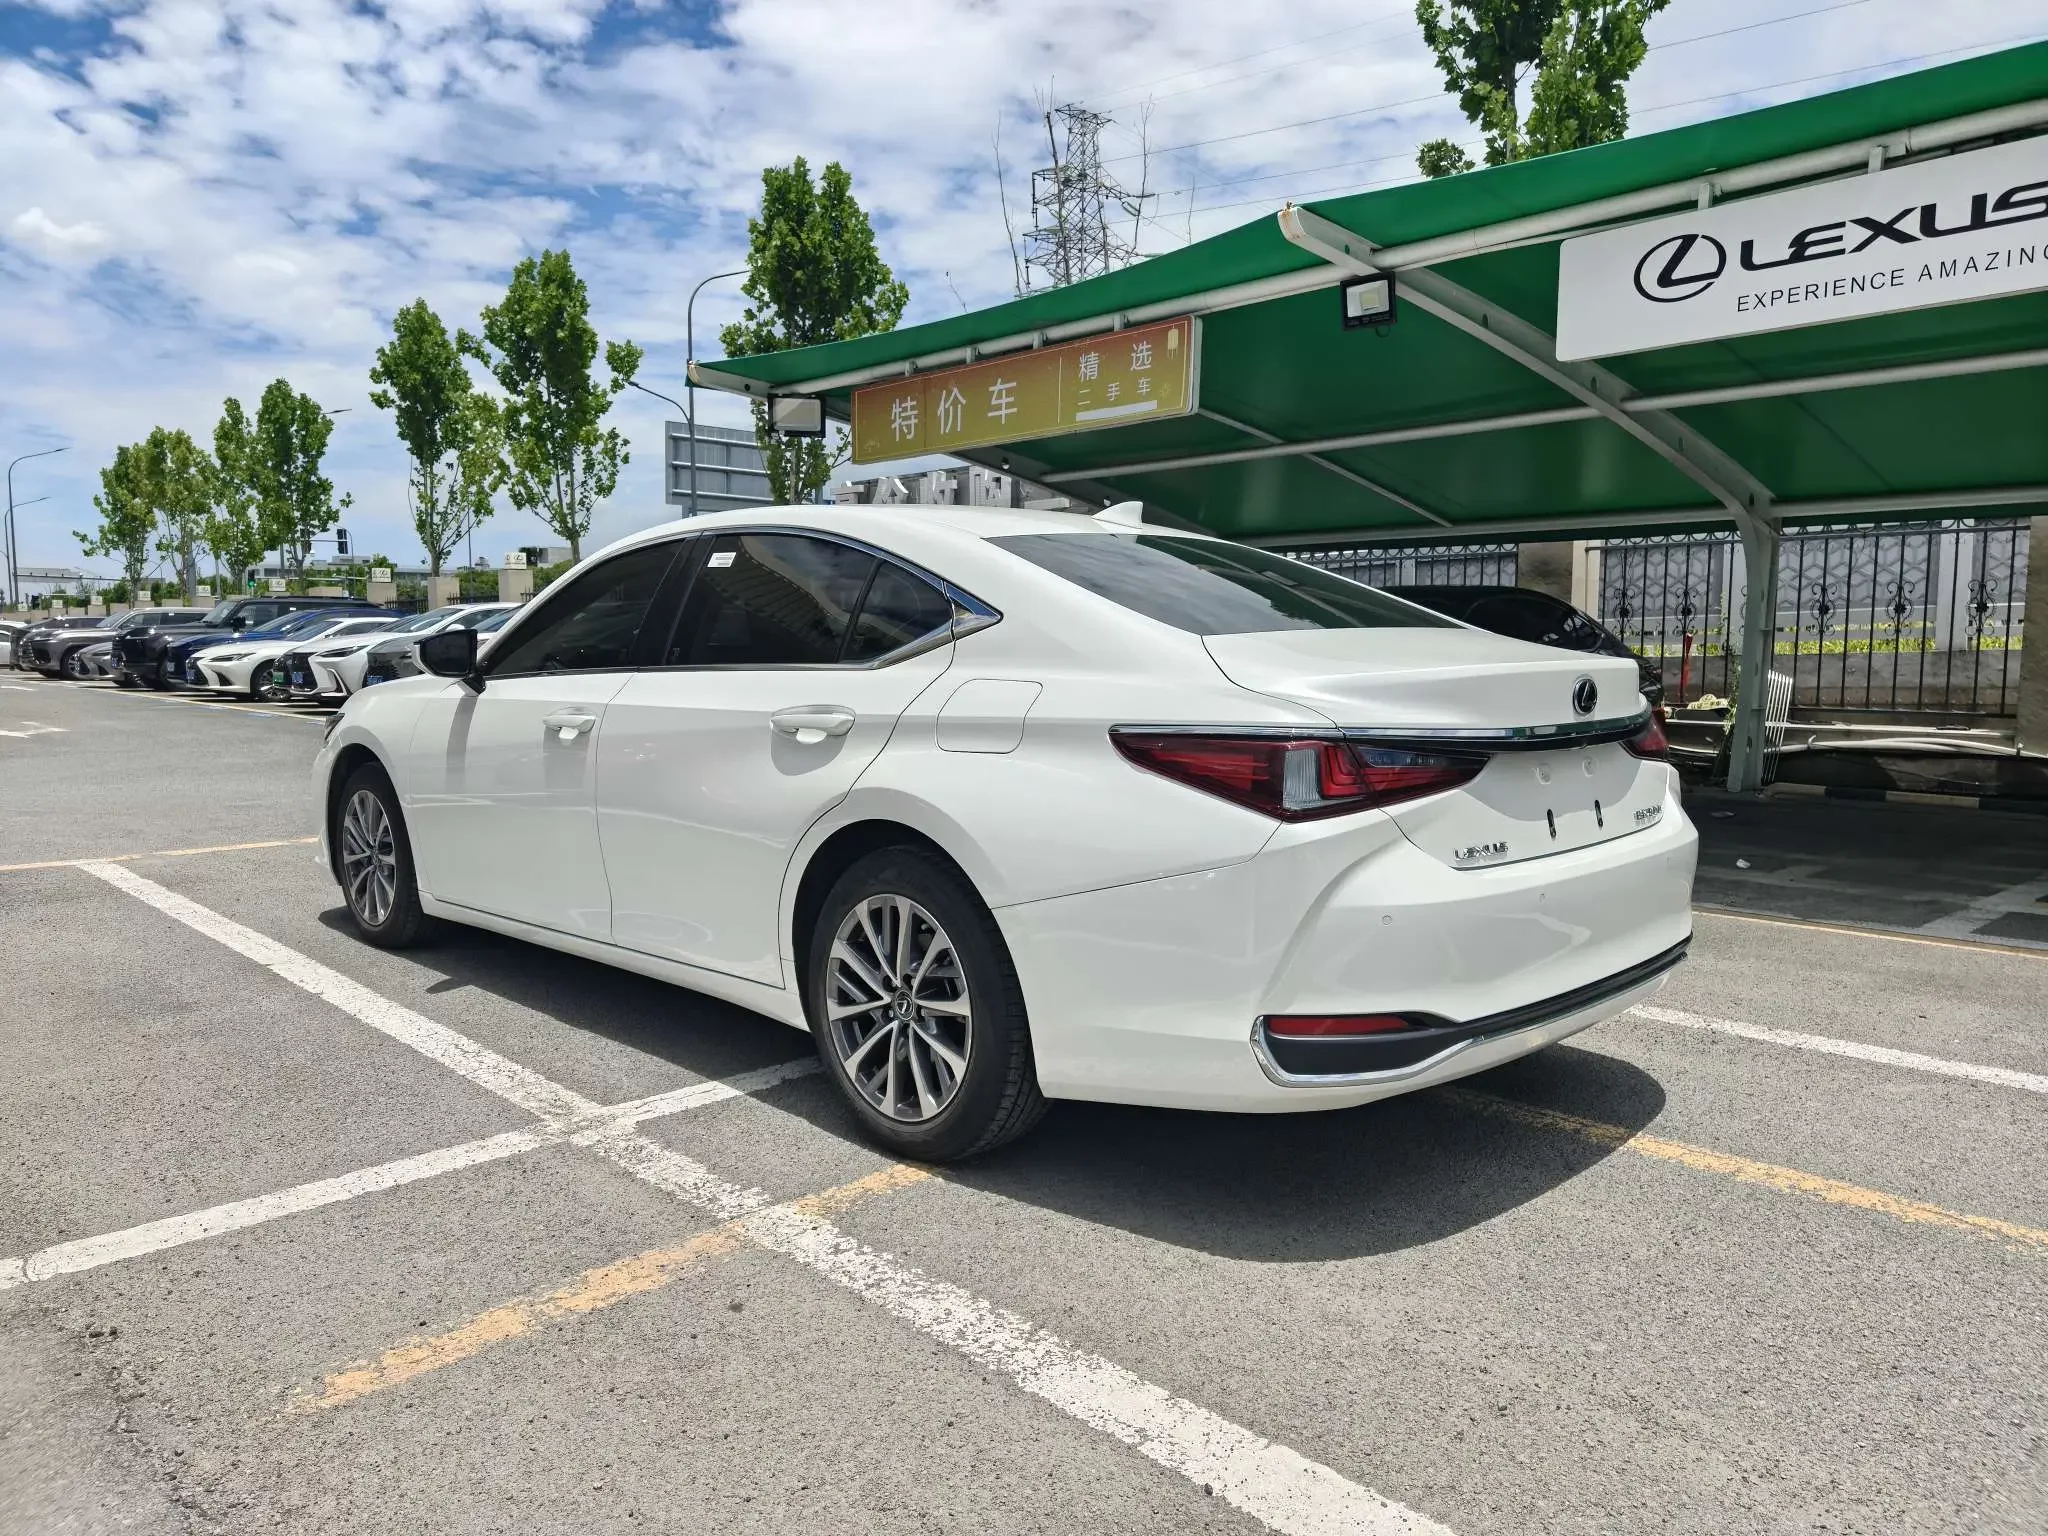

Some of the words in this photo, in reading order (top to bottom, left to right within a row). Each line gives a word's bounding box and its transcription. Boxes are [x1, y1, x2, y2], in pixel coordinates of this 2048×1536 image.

[1740, 181, 2048, 271] LEXUS
[1737, 268, 1905, 313] EXPERIENCE
[1918, 243, 2048, 283] AMAZIN
[1078, 340, 1152, 382] 精选
[891, 378, 1018, 442] 特价车
[1078, 377, 1152, 405] 二手车
[1453, 841, 1509, 860] LEXUS
